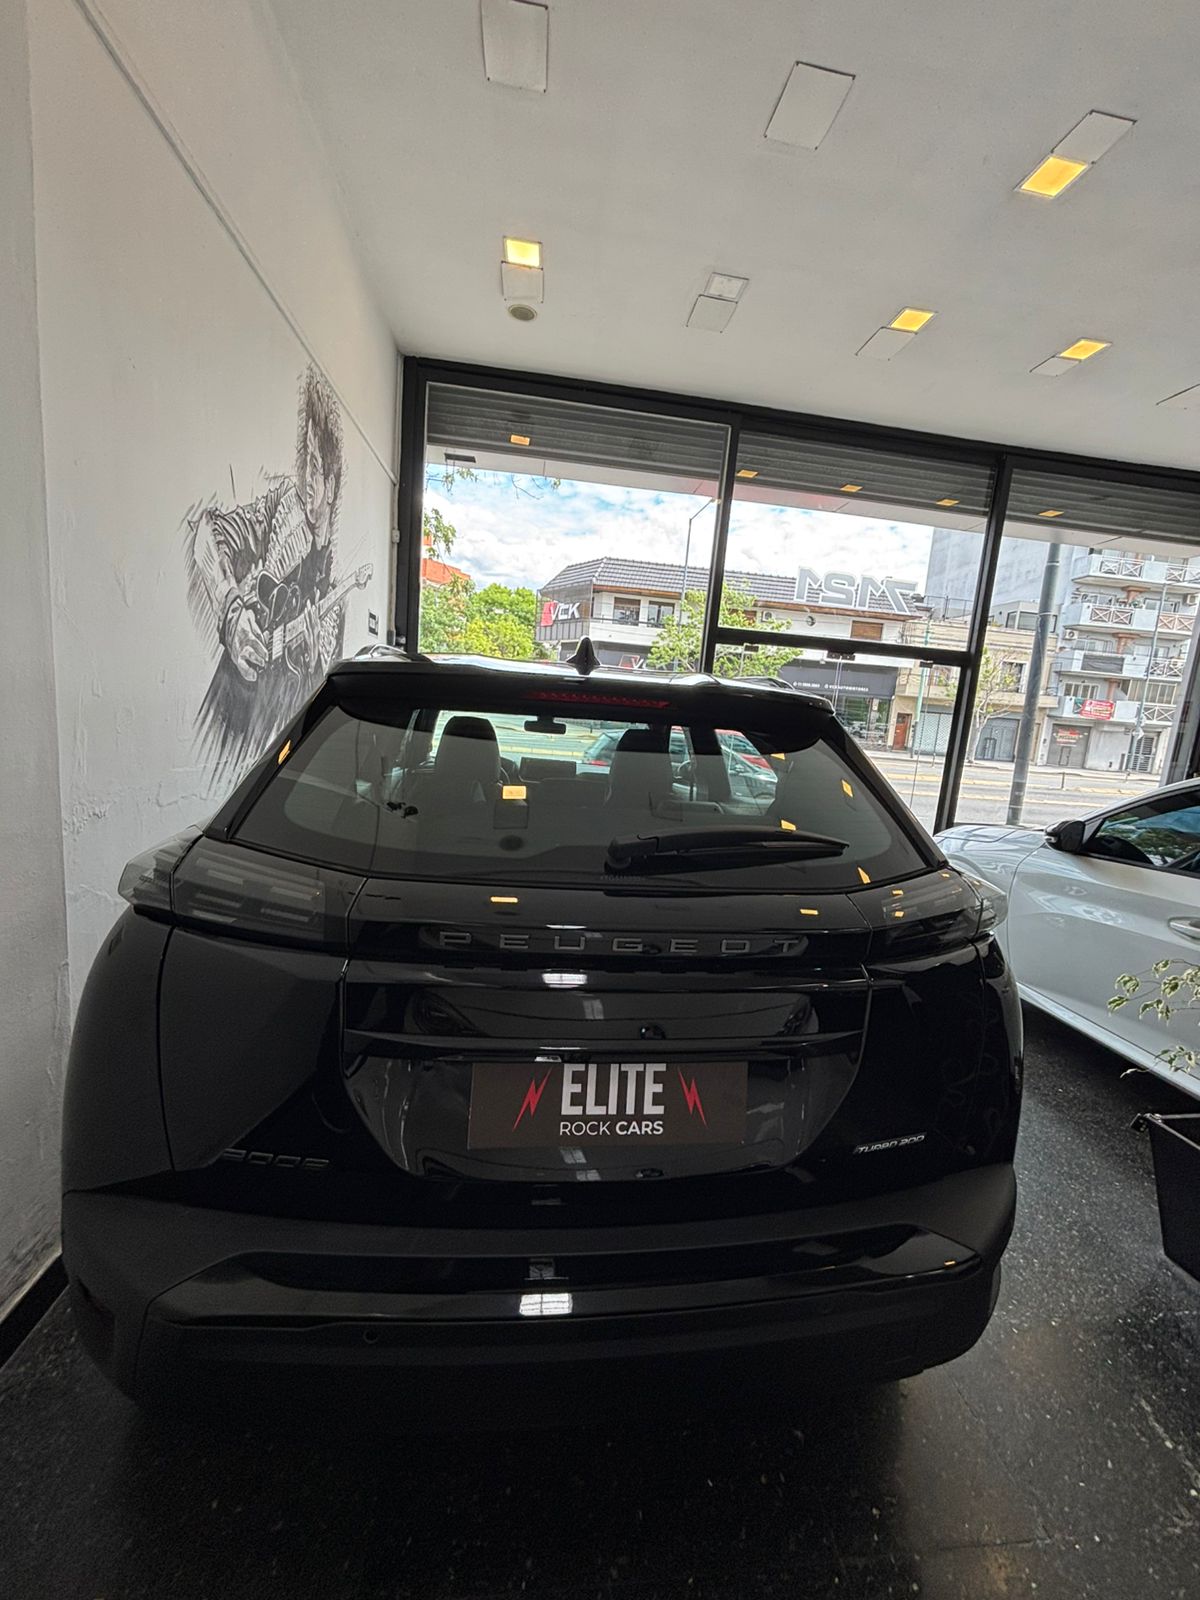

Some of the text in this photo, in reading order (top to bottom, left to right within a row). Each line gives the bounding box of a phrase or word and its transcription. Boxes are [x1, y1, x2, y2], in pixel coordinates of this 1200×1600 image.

[550, 602, 580, 621] VCK
[438, 930, 800, 954] PEUGEOT
[560, 1063, 667, 1116] ELITE
[559, 1120, 665, 1137] ROCK CARS
[857, 1140, 898, 1154] TURBO
